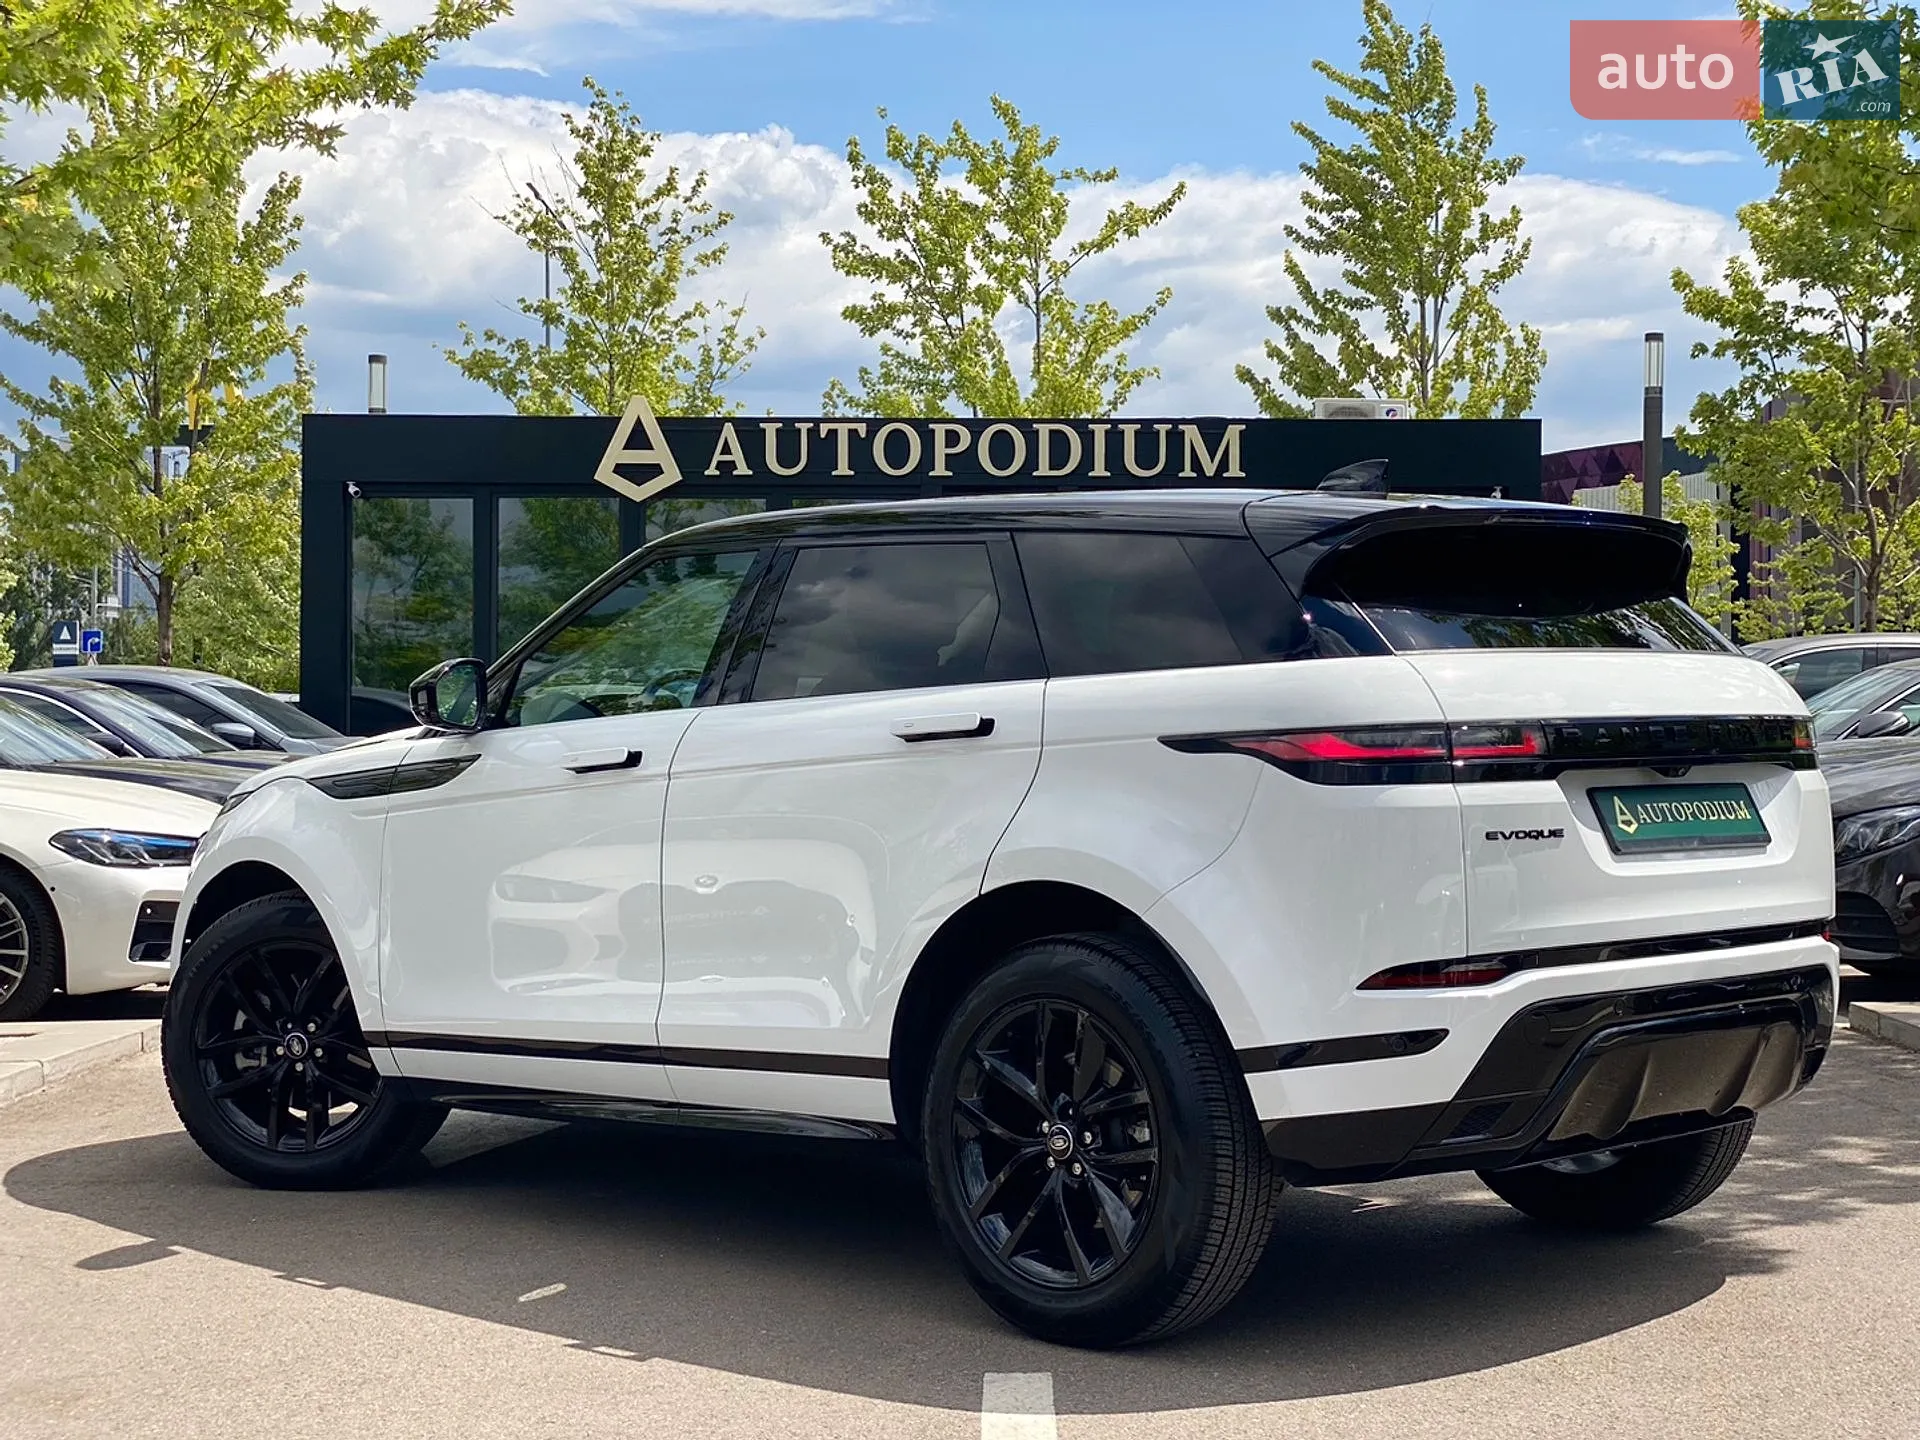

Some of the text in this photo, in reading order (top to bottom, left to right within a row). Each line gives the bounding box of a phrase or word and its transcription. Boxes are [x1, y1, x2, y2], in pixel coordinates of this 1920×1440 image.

[704, 422, 1247, 478] AUTOPODIUM
[1637, 800, 1751, 824] AUTOPODIUM
[1485, 828, 1565, 841] EVOQUE
